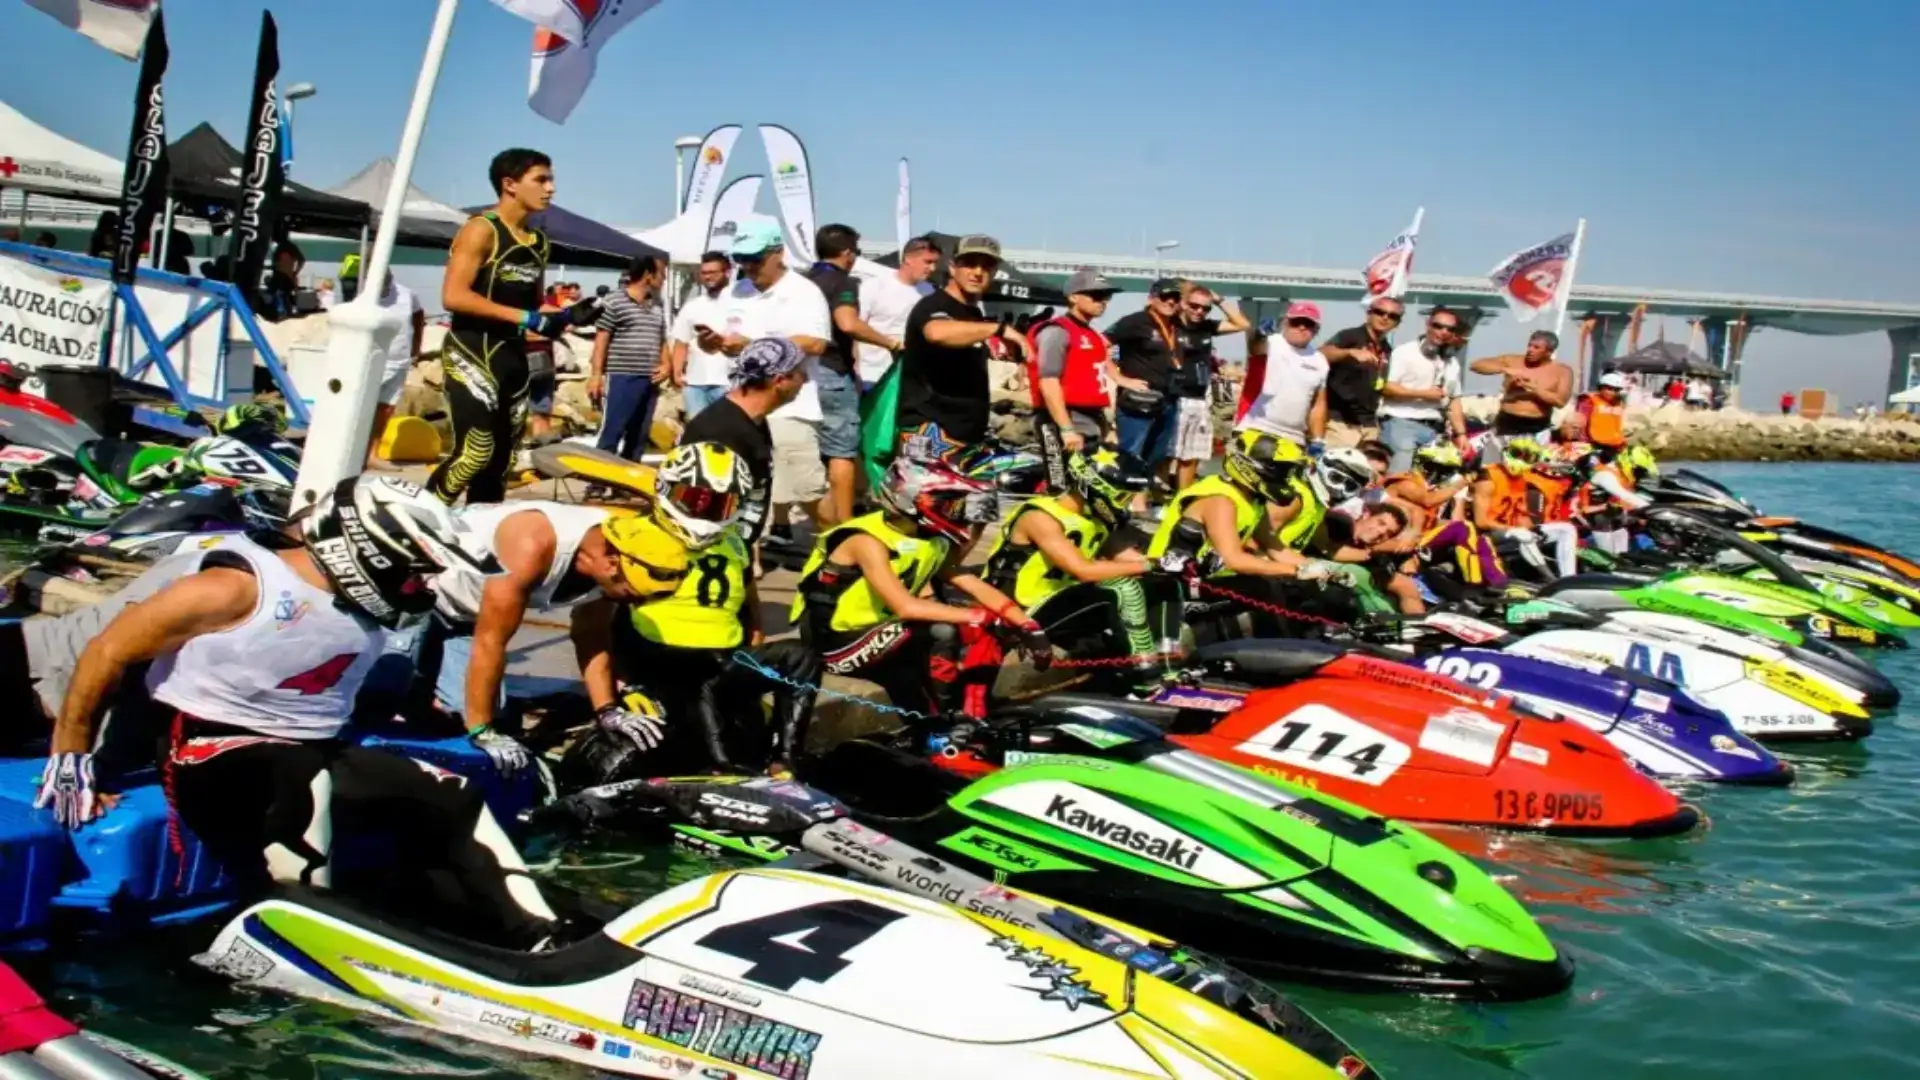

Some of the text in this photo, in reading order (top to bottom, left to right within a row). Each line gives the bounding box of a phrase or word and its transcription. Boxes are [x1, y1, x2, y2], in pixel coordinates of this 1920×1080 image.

[697, 554, 731, 608] 8
[1269, 720, 1387, 776] 114
[1251, 764, 1319, 791] SOLAS
[1044, 794, 1203, 872] Kawasaki
[694, 899, 908, 992] 4
